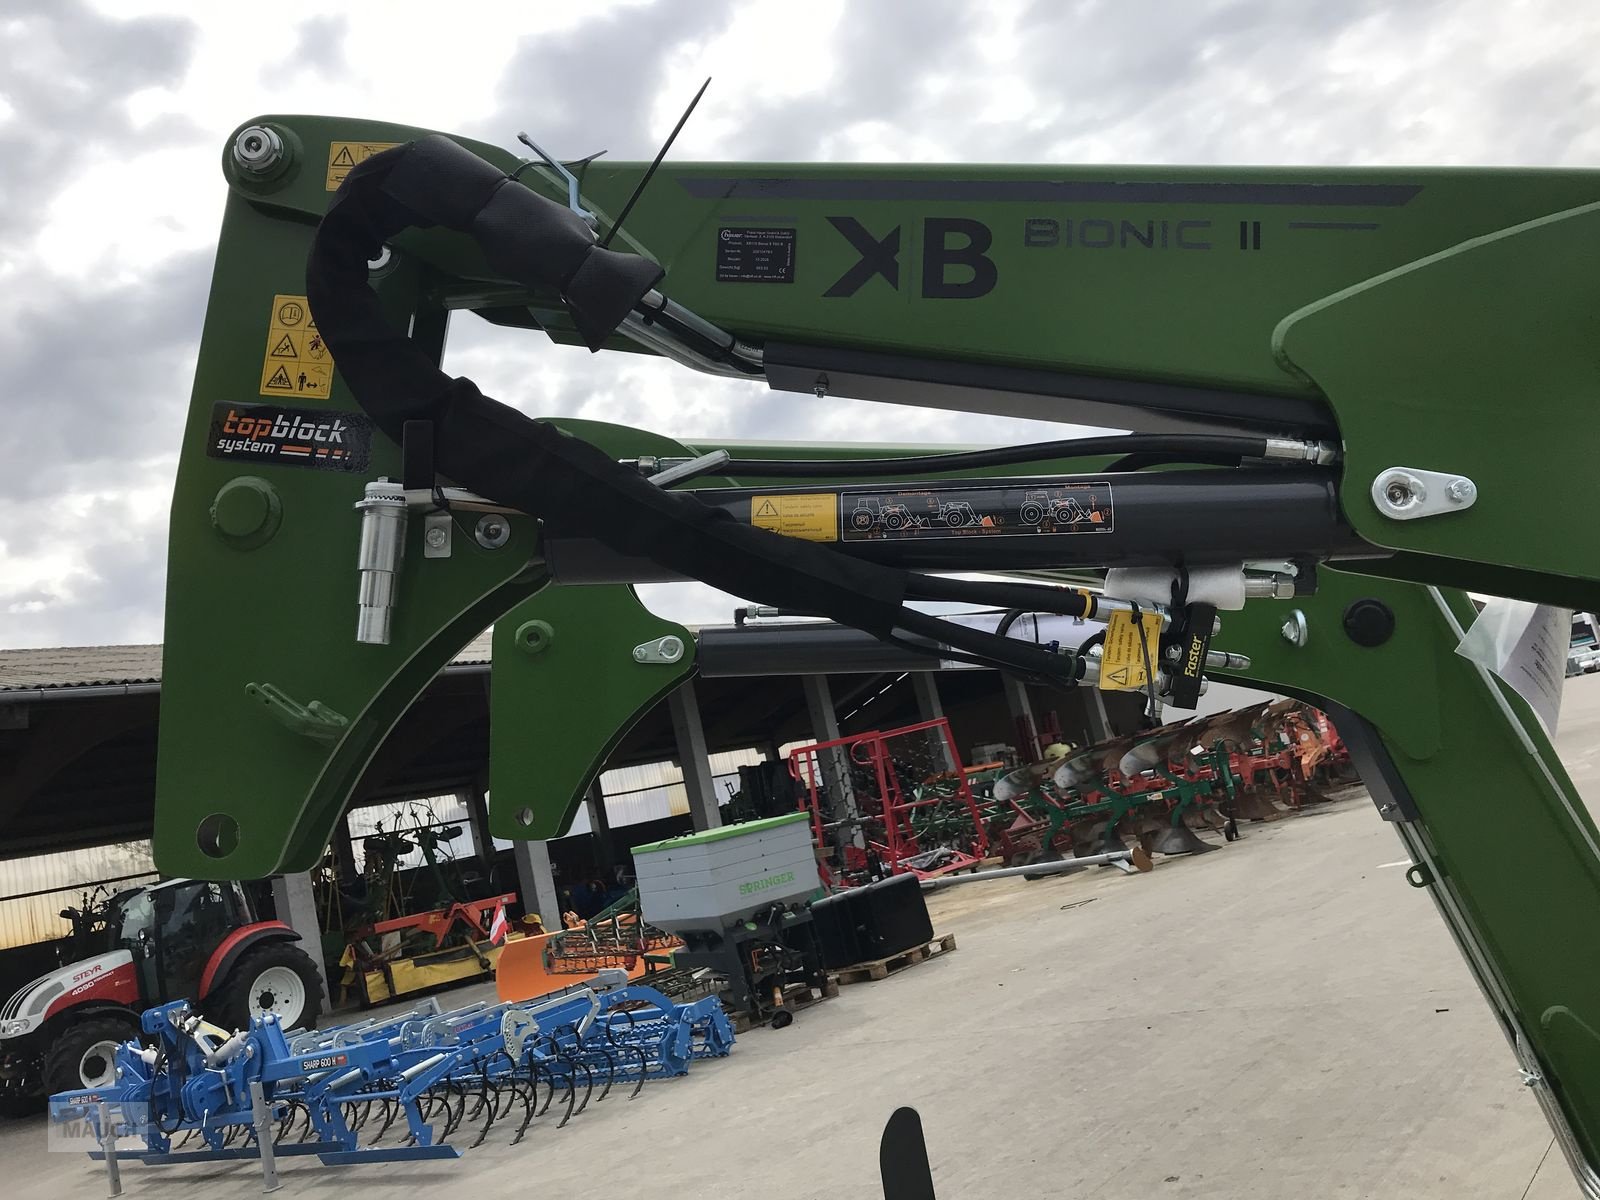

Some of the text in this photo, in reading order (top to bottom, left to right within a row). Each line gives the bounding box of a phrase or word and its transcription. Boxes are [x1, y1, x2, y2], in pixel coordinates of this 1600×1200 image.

[1024, 218, 1212, 250] BIONIC
[223, 410, 347, 443] topblock
[217, 438, 276, 453] system
[1184, 635, 1202, 677] Faster
[739, 872, 795, 895] SPRINGER
[73, 965, 102, 983] STEYR
[71, 981, 95, 996] 4090
[303, 1059, 320, 1070] SHARP
[320, 1058, 331, 1067] 600
